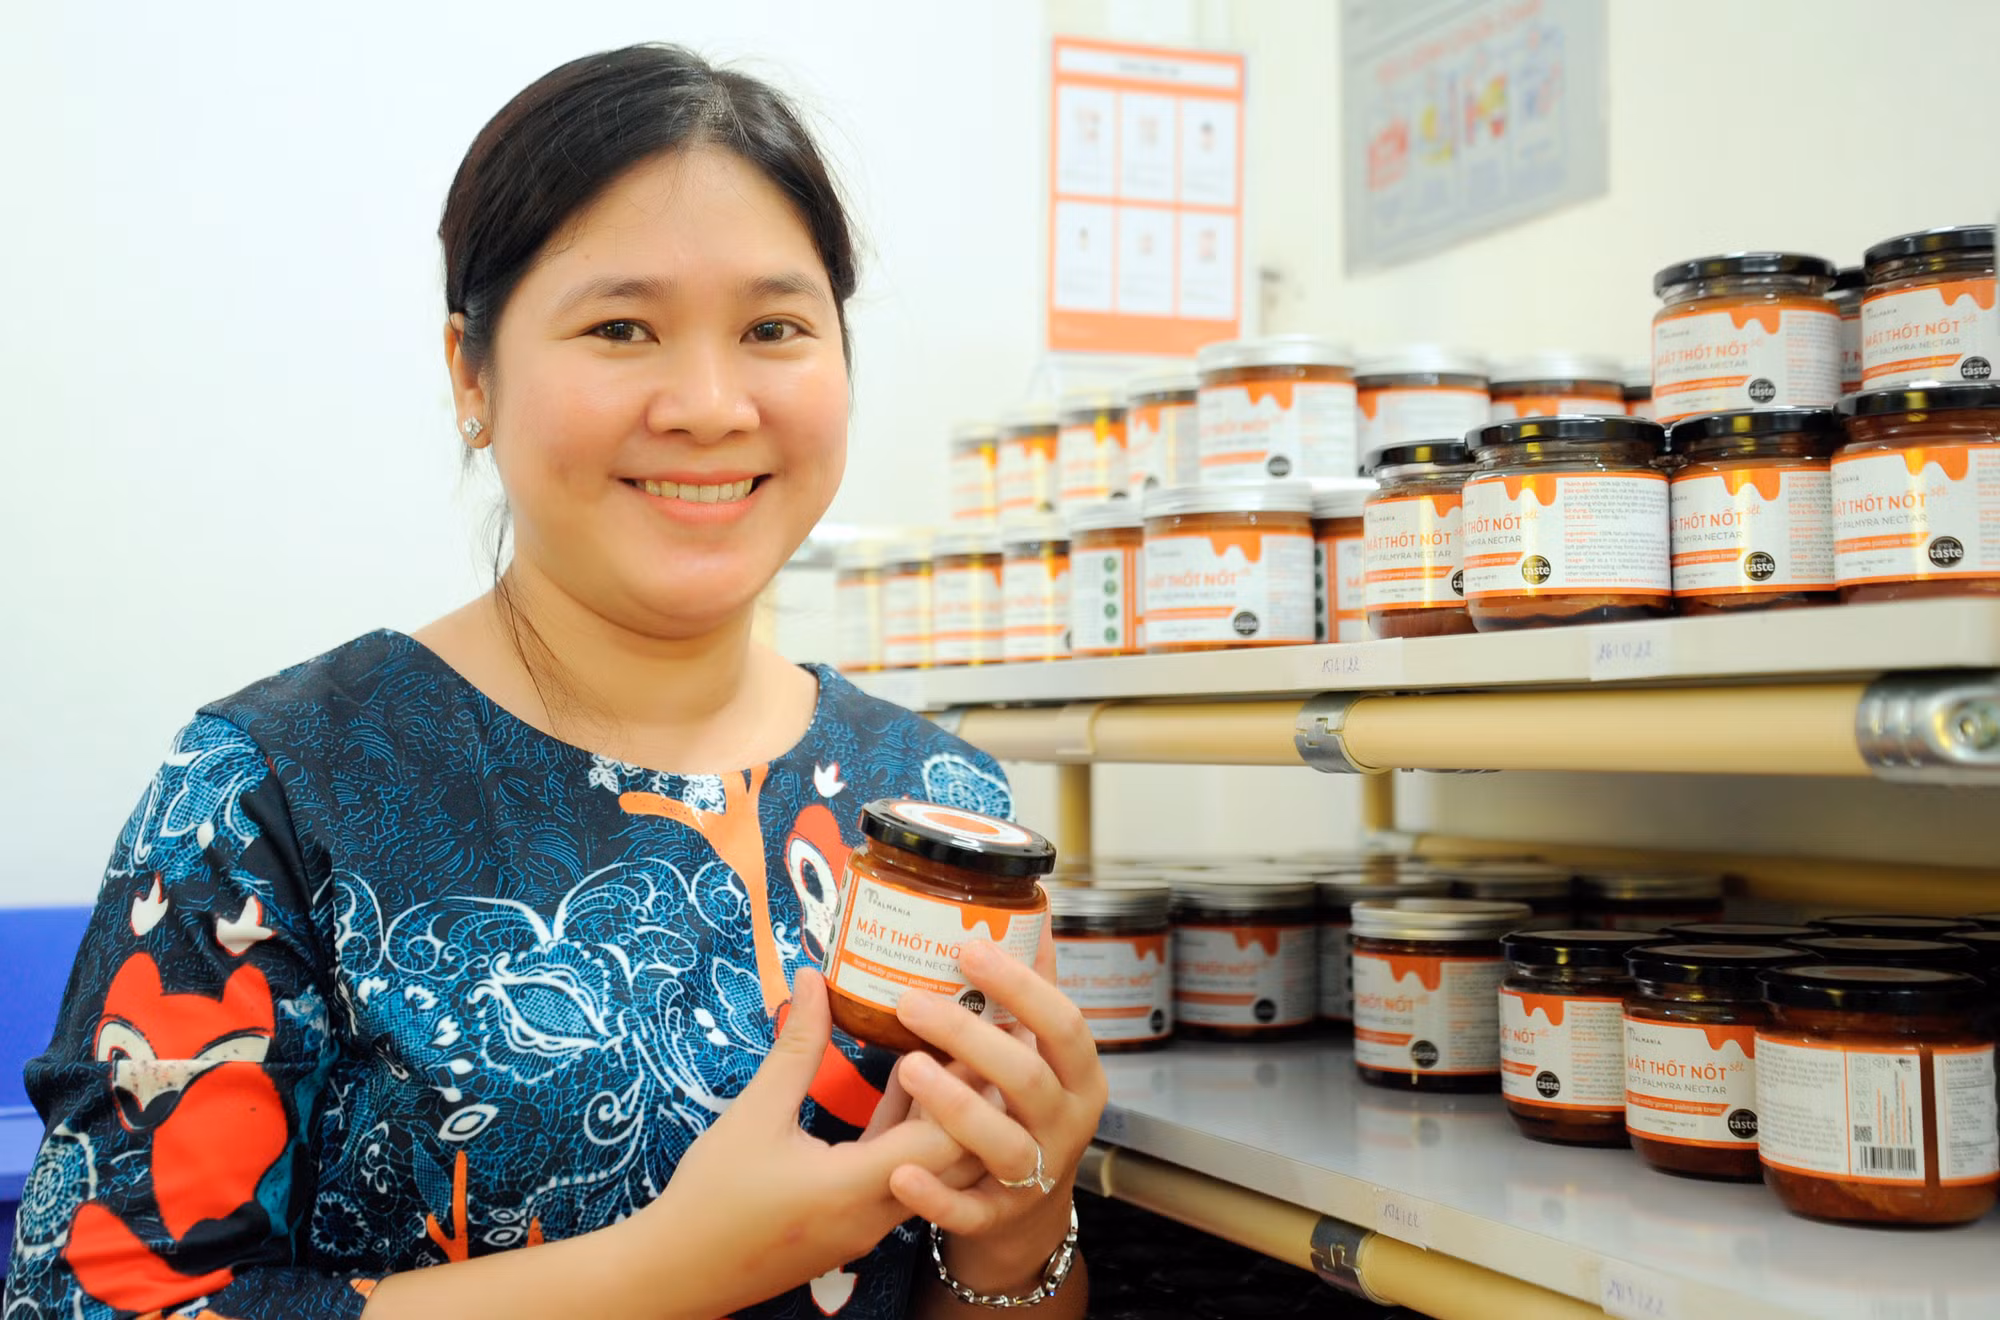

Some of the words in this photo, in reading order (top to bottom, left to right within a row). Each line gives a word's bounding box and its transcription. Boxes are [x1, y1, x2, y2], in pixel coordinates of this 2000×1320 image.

[1925, 317, 1960, 335] NỐT
[1716, 338, 1748, 357] NỐT
[1919, 338, 1960, 349] NECTAR
[1963, 366, 1990, 375] taste
[1750, 387, 1775, 396] taste
[1849, 491, 1884, 514] THỐT
[1888, 489, 1927, 511] NỐT
[1493, 511, 1522, 531] NỐT
[1710, 507, 1743, 526] NỐT
[1882, 514, 1928, 526] NECTAR
[1385, 530, 1415, 549] THỐT
[1420, 528, 1451, 545] NỐT
[1488, 534, 1521, 545] NECTAR
[1705, 531, 1743, 541] NECTAR
[1930, 548, 1963, 559] taste
[1524, 566, 1550, 575] taste
[1745, 562, 1774, 572] taste
[857, 916, 887, 941] MẬT
[891, 929, 933, 954] THỐT
[854, 936, 875, 952] SOFT
[876, 943, 922, 966] PALMYRA
[925, 959, 962, 975] NECTA
[1649, 1059, 1686, 1079] THỐT
[1691, 1061, 1727, 1081] NỐT
[1537, 1080, 1560, 1091] taste
[1643, 1078, 1682, 1091] PALMYRA
[1684, 1083, 1727, 1095] NECTAR
[1729, 1119, 1757, 1130] taste
